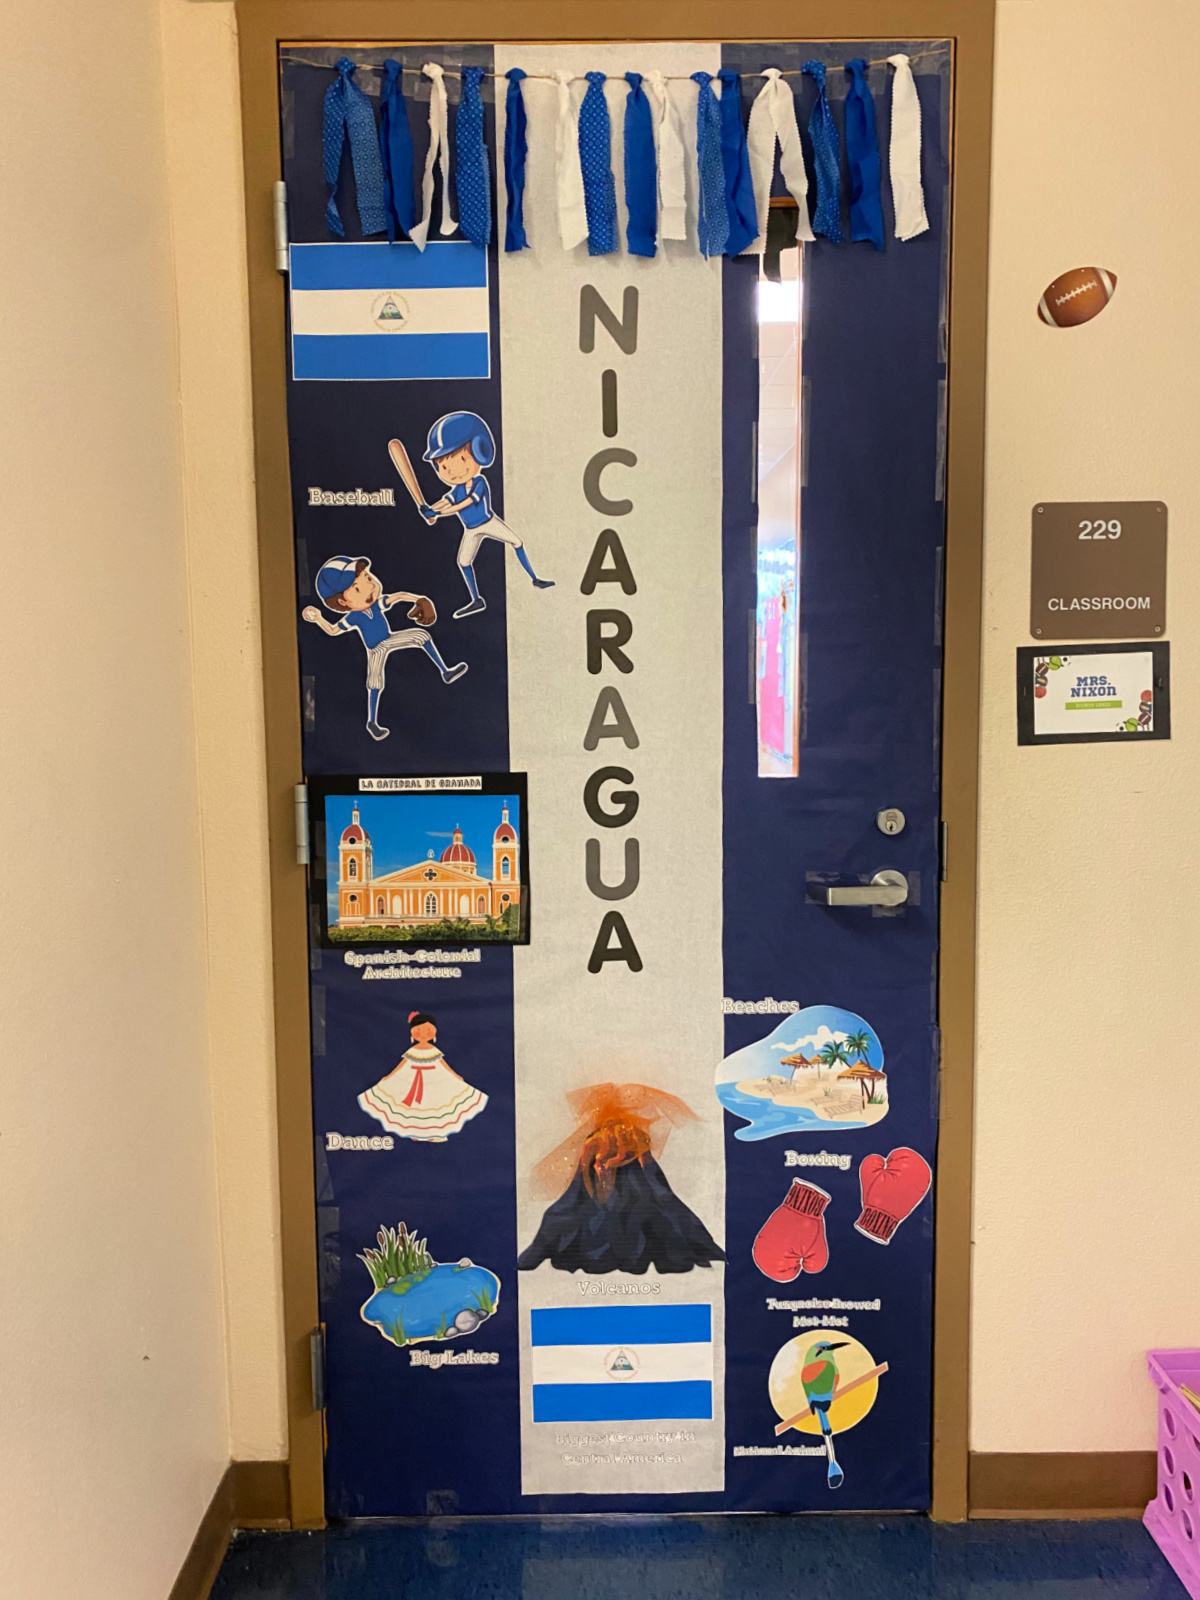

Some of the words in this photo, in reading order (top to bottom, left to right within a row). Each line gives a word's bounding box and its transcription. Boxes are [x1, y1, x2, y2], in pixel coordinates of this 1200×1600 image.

[308, 487, 395, 506] Baseball
[1078, 520, 1122, 540] 229
[1048, 596, 1151, 611] CLASSROOM
[579, 284, 643, 974] NICARAGUA
[1076, 676, 1111, 686] MRS.
[361, 780, 374, 789] LA
[425, 780, 436, 788] DE
[362, 966, 462, 980] Architecture
[722, 998, 799, 1014] Beaches
[326, 1132, 394, 1150] Dance
[785, 1151, 851, 1169] Boxing
[577, 1281, 662, 1296] Volcanos
[409, 1350, 443, 1369] Big
[444, 1349, 499, 1365] Lakes
